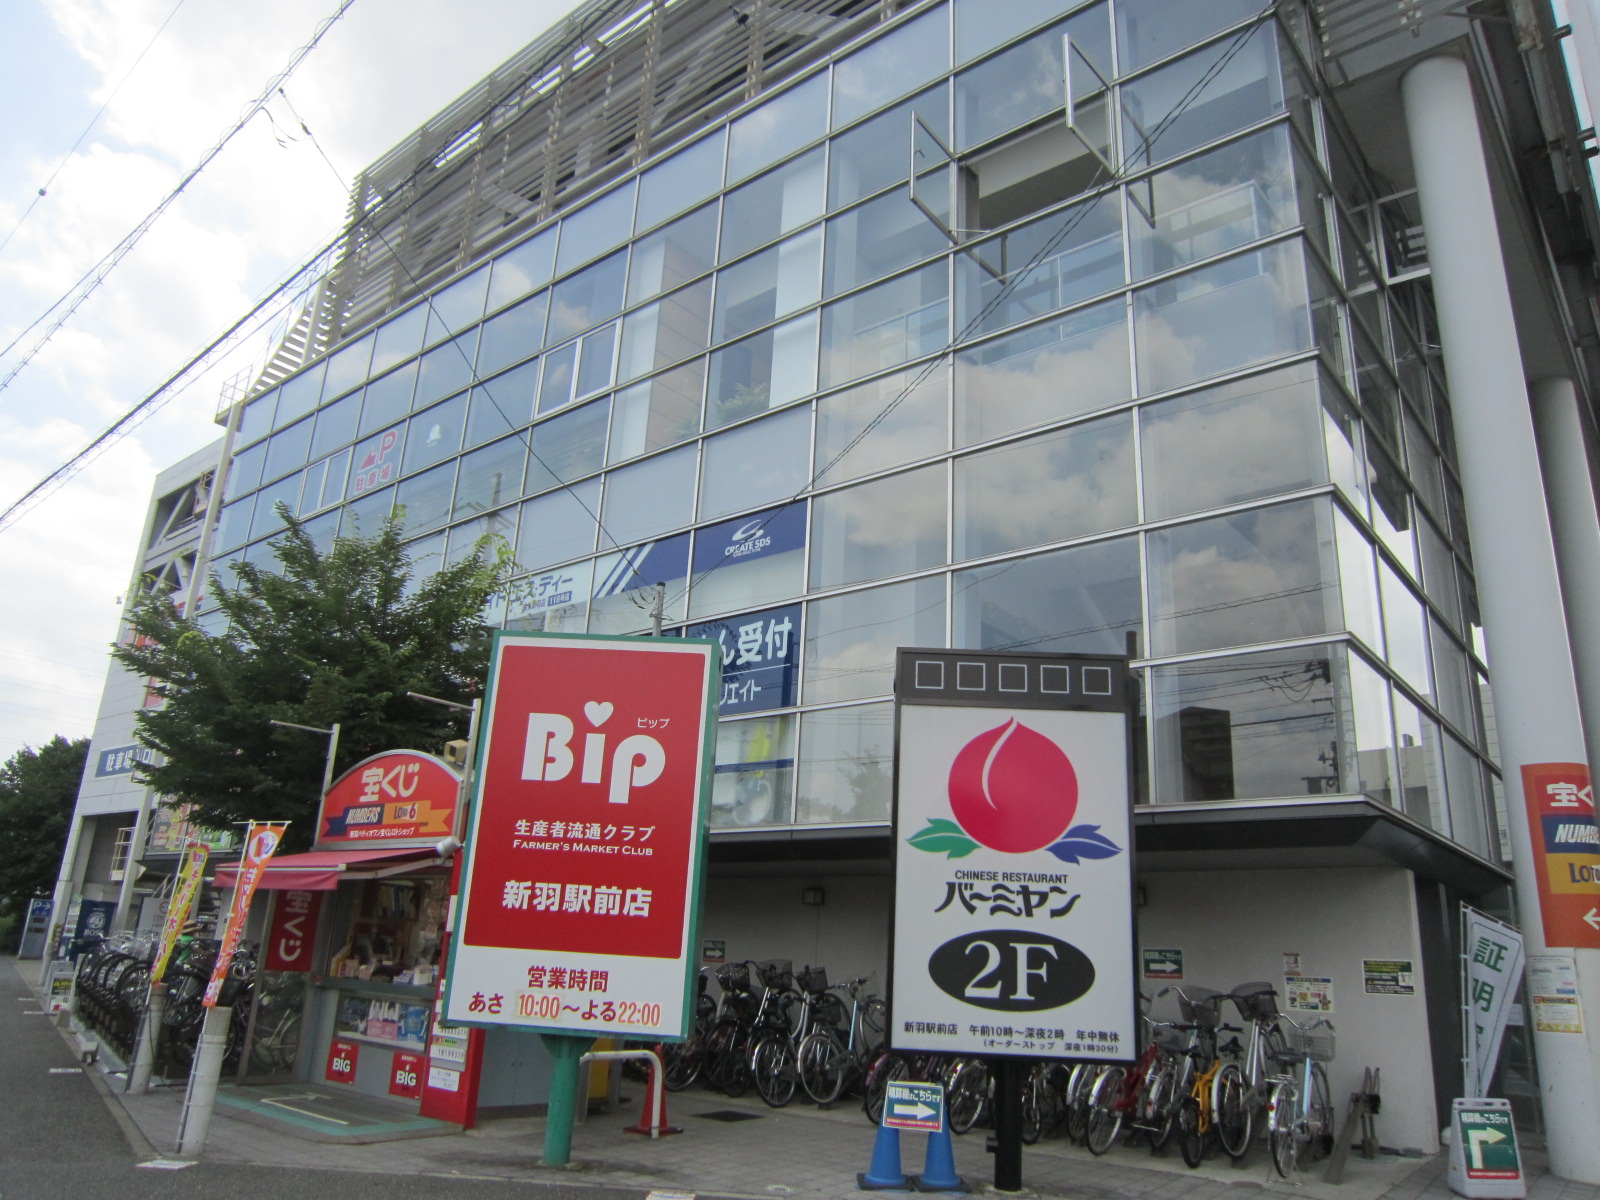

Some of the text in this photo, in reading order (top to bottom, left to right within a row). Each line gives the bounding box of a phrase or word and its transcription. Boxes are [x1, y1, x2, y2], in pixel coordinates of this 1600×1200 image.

[378, 430, 397, 463] P
[725, 537, 771, 556] CREATE SDS
[637, 716, 671, 729] ピップ
[521, 701, 667, 804] Bip
[359, 762, 420, 802] 宝くじ
[345, 806, 381, 825] NUMBERS
[409, 803, 417, 820] 6
[514, 819, 656, 842] 生産者流通クラブ
[513, 839, 653, 856] FARMER'S MARKET CLUB
[955, 870, 1068, 884] CHINESE RESTAURANT
[502, 880, 653, 917] 新羽駅前店
[934, 881, 1081, 919] バーミヤン
[527, 965, 609, 992] 営業時間
[964, 939, 1059, 1000] 2F
[468, 991, 505, 1015] あさ
[904, 1021, 958, 1035] 新羽駅前店
[1076, 1029, 1120, 1043] 年中無休
[332, 1057, 351, 1073] BIG
[395, 1070, 417, 1087] BIG
